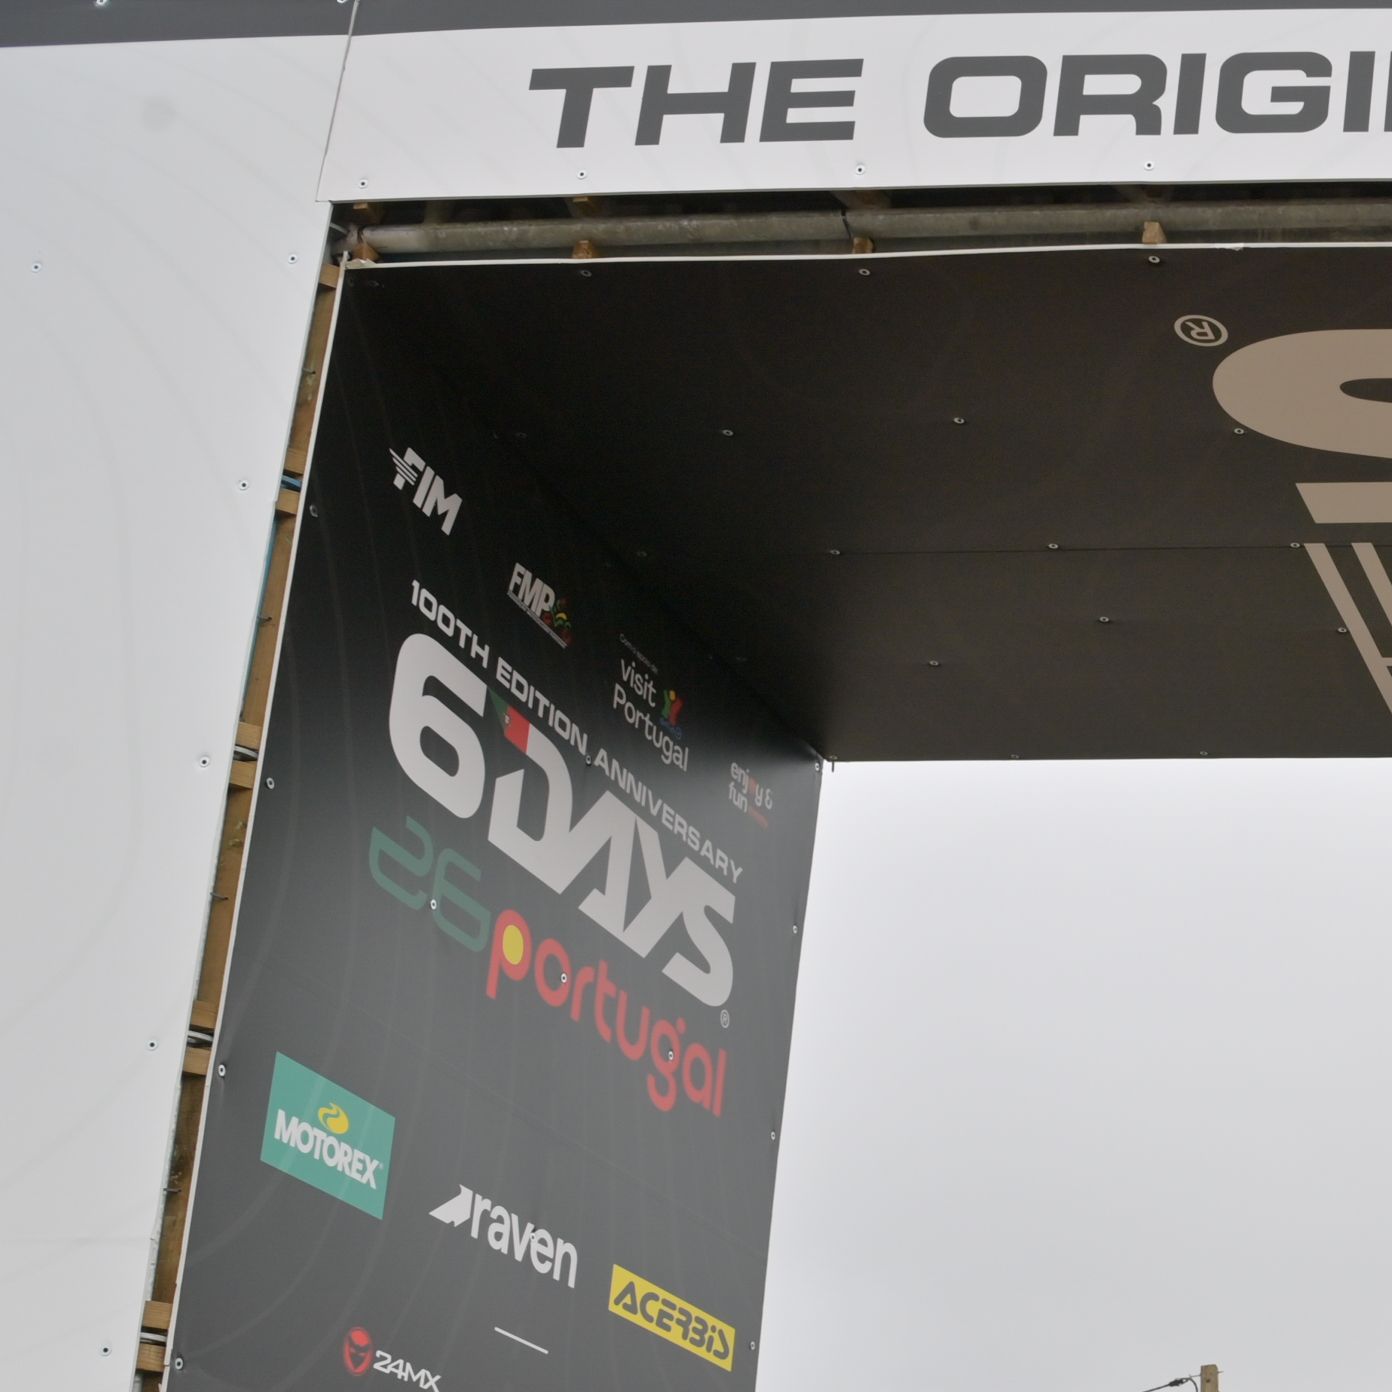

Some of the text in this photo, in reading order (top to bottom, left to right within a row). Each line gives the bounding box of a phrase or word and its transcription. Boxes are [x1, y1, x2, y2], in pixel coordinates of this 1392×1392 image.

[529, 57, 864, 149] THE
[389, 447, 463, 535] FIM
[508, 562, 555, 618] FMP
[613, 683, 689, 772] Portugal
[620, 658, 657, 707] visit
[411, 579, 490, 669] 100TH
[496, 657, 588, 756] EDITION
[594, 748, 743, 884] ANNIVERSARY
[389, 633, 735, 1007] 6DAYS
[729, 782, 749, 813] fun
[369, 815, 491, 953] 26
[486, 909, 728, 1117] portugal
[274, 1109, 378, 1189] MOTOREX
[471, 1194, 577, 1288] raven
